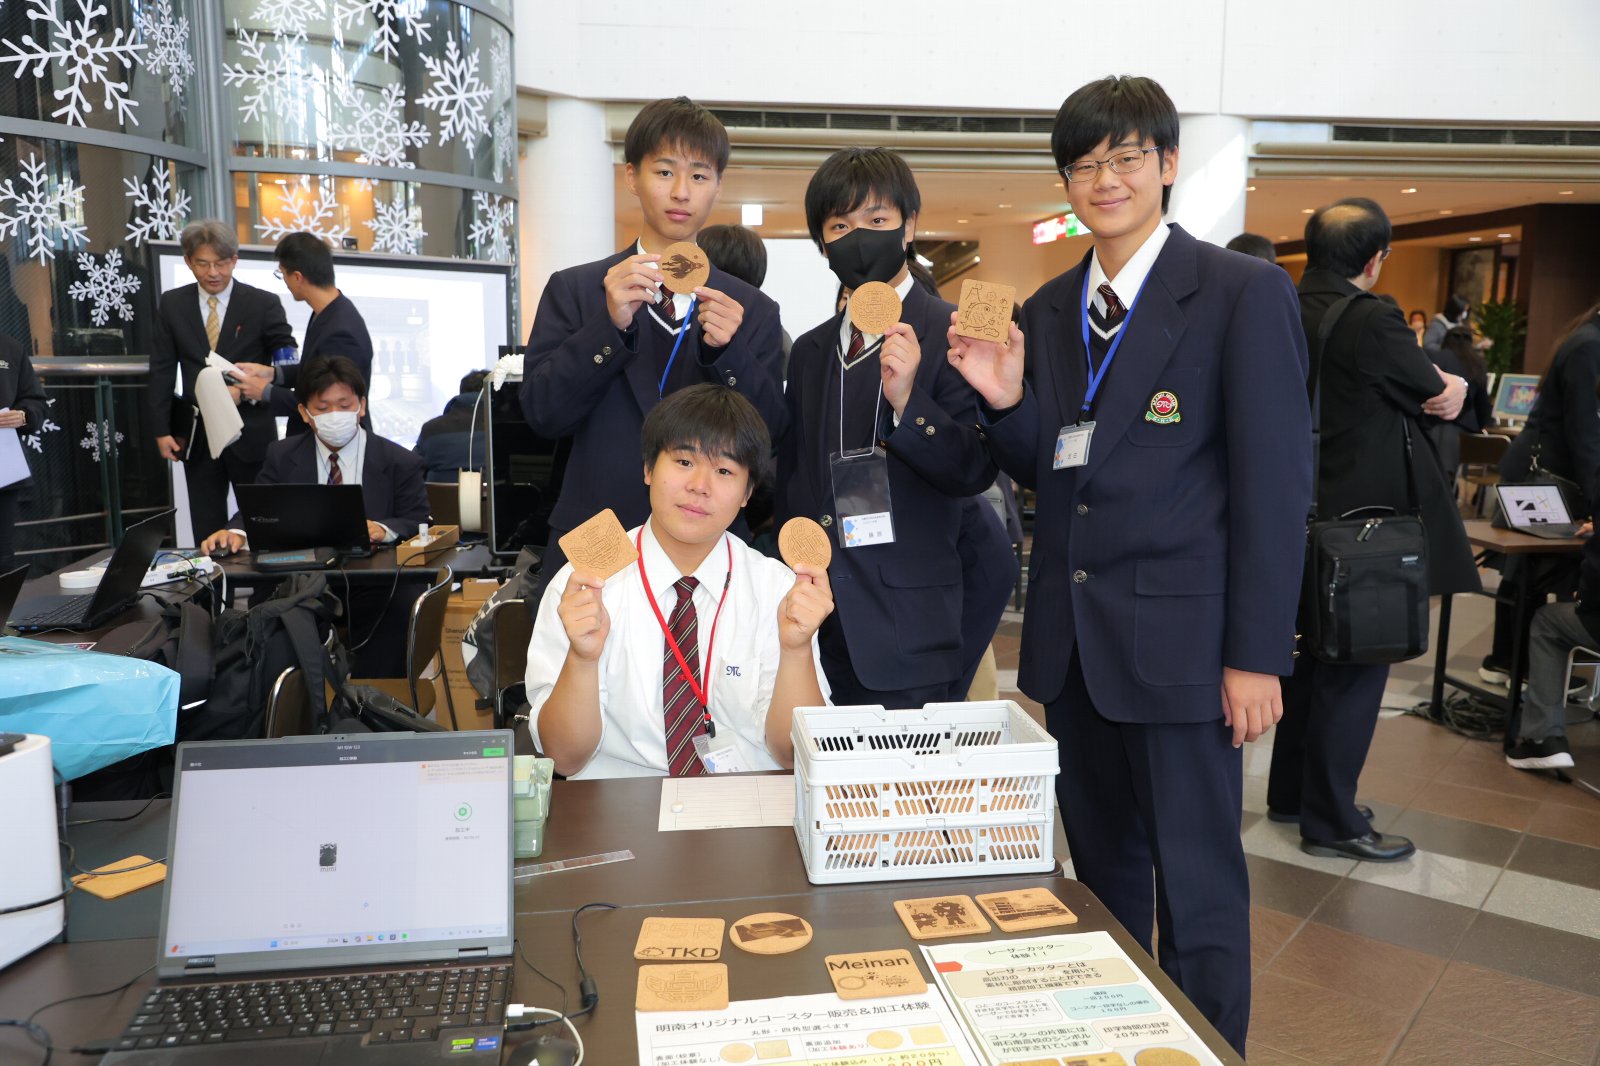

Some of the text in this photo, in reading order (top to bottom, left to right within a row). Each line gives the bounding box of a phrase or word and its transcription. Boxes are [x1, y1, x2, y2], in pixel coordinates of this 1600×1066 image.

[667, 947, 719, 958] TKD
[987, 944, 1065, 955] レーザーカッター
[828, 957, 910, 971] Meinan
[985, 962, 1087, 976] レーザーカッターとは
[989, 1026, 1087, 1040] コースターの片面には
[1103, 1021, 1170, 1033] 印字時間の目安
[992, 1034, 1091, 1047] 明石南高校のシンボル
[1002, 1040, 1089, 1054] が印字されています
